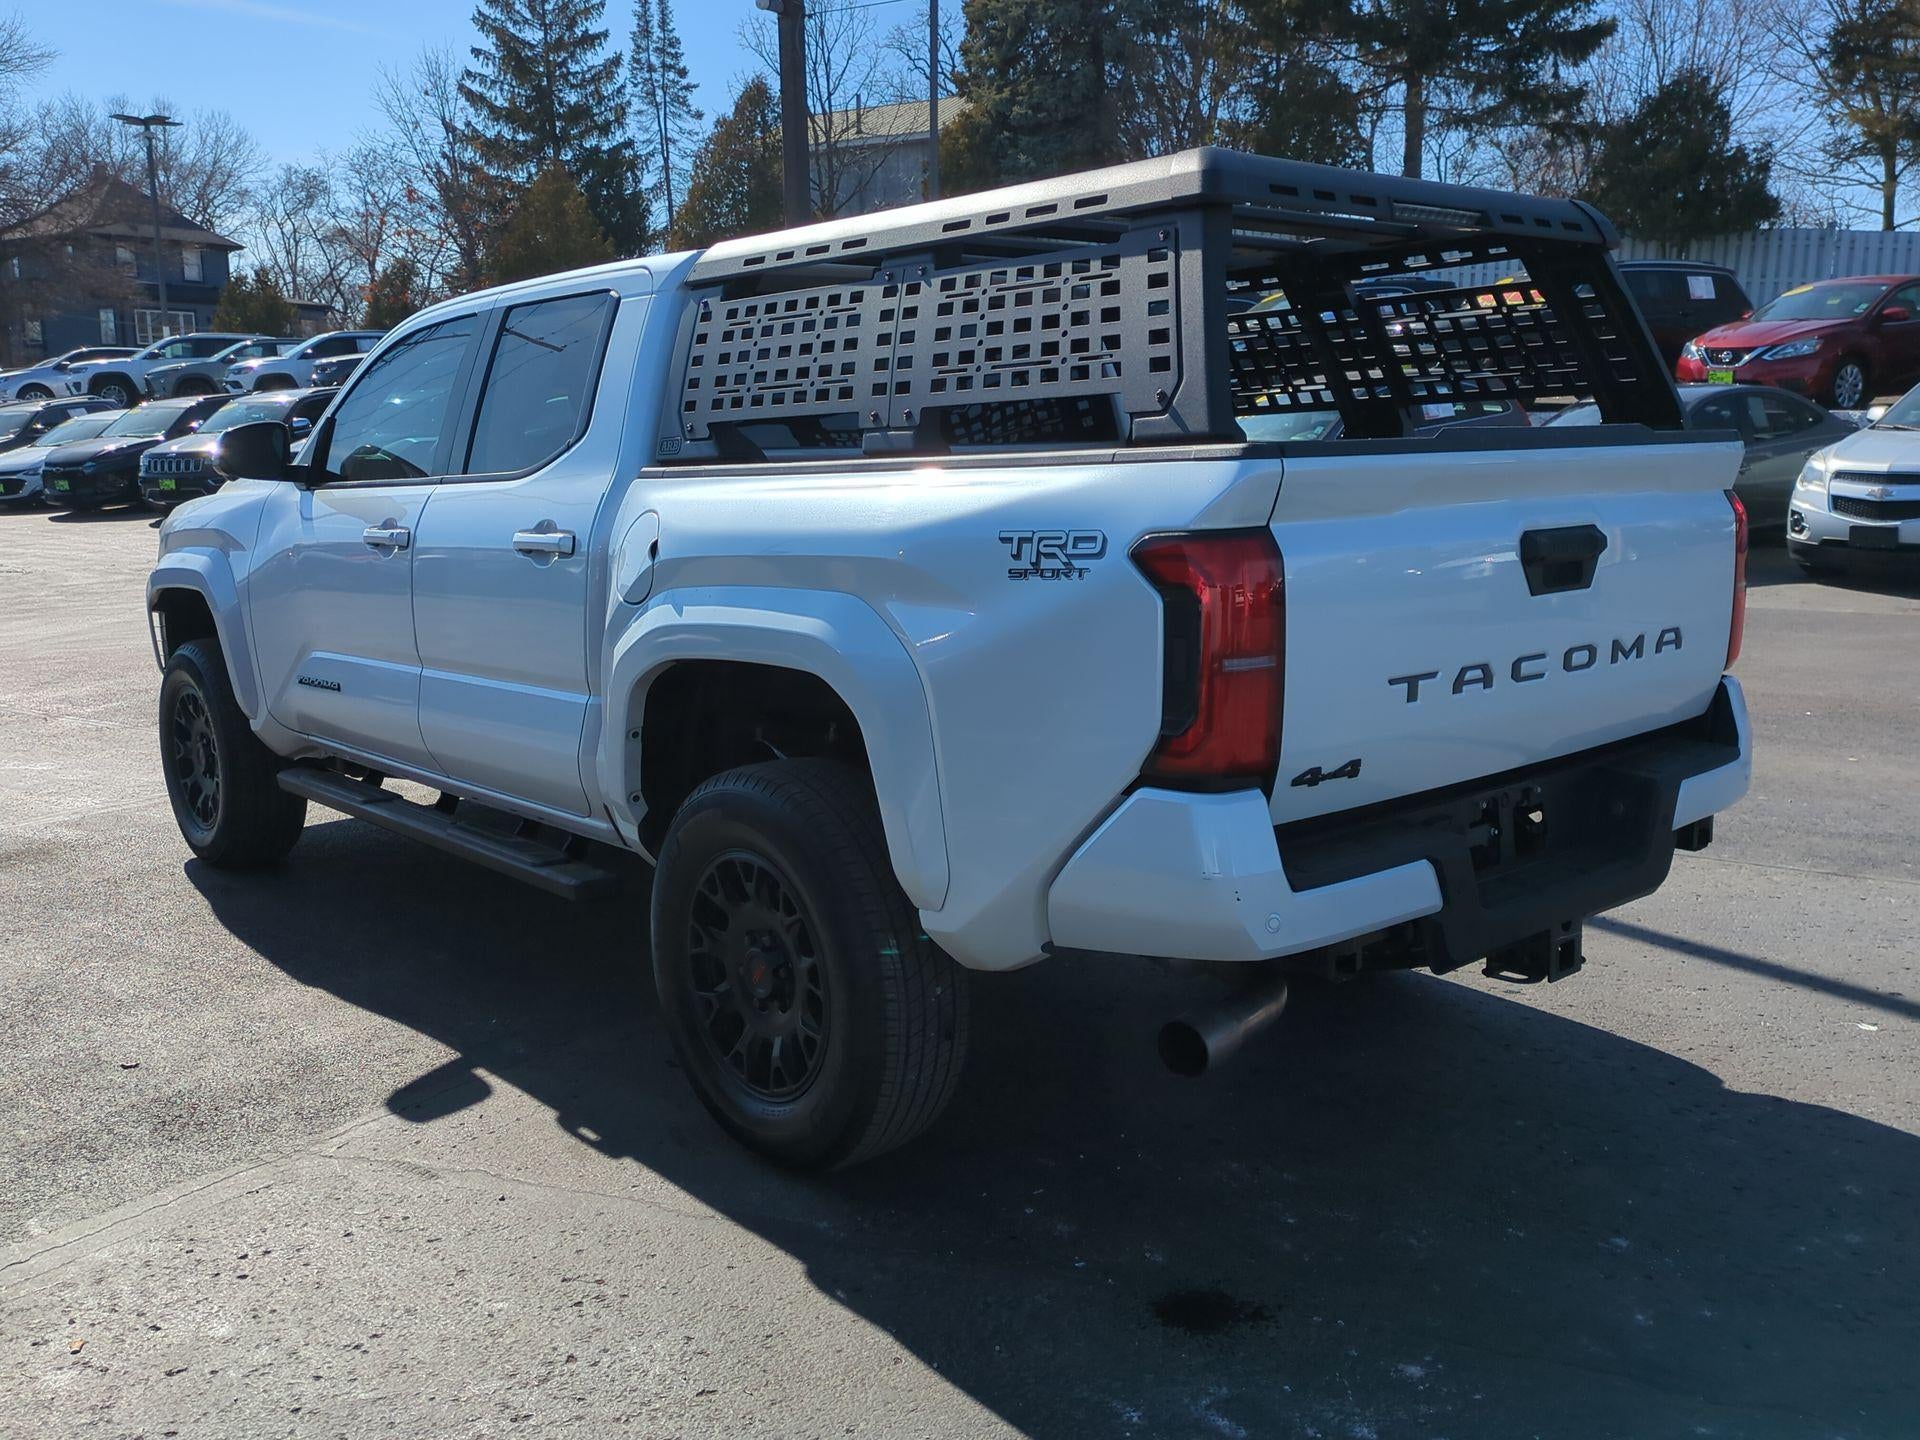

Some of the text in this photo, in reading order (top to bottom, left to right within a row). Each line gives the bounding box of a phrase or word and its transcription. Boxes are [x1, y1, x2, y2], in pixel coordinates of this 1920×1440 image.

[998, 529, 1108, 569] TRD
[1007, 568, 1091, 580] SPORT
[1388, 626, 1683, 703] TACOMA
